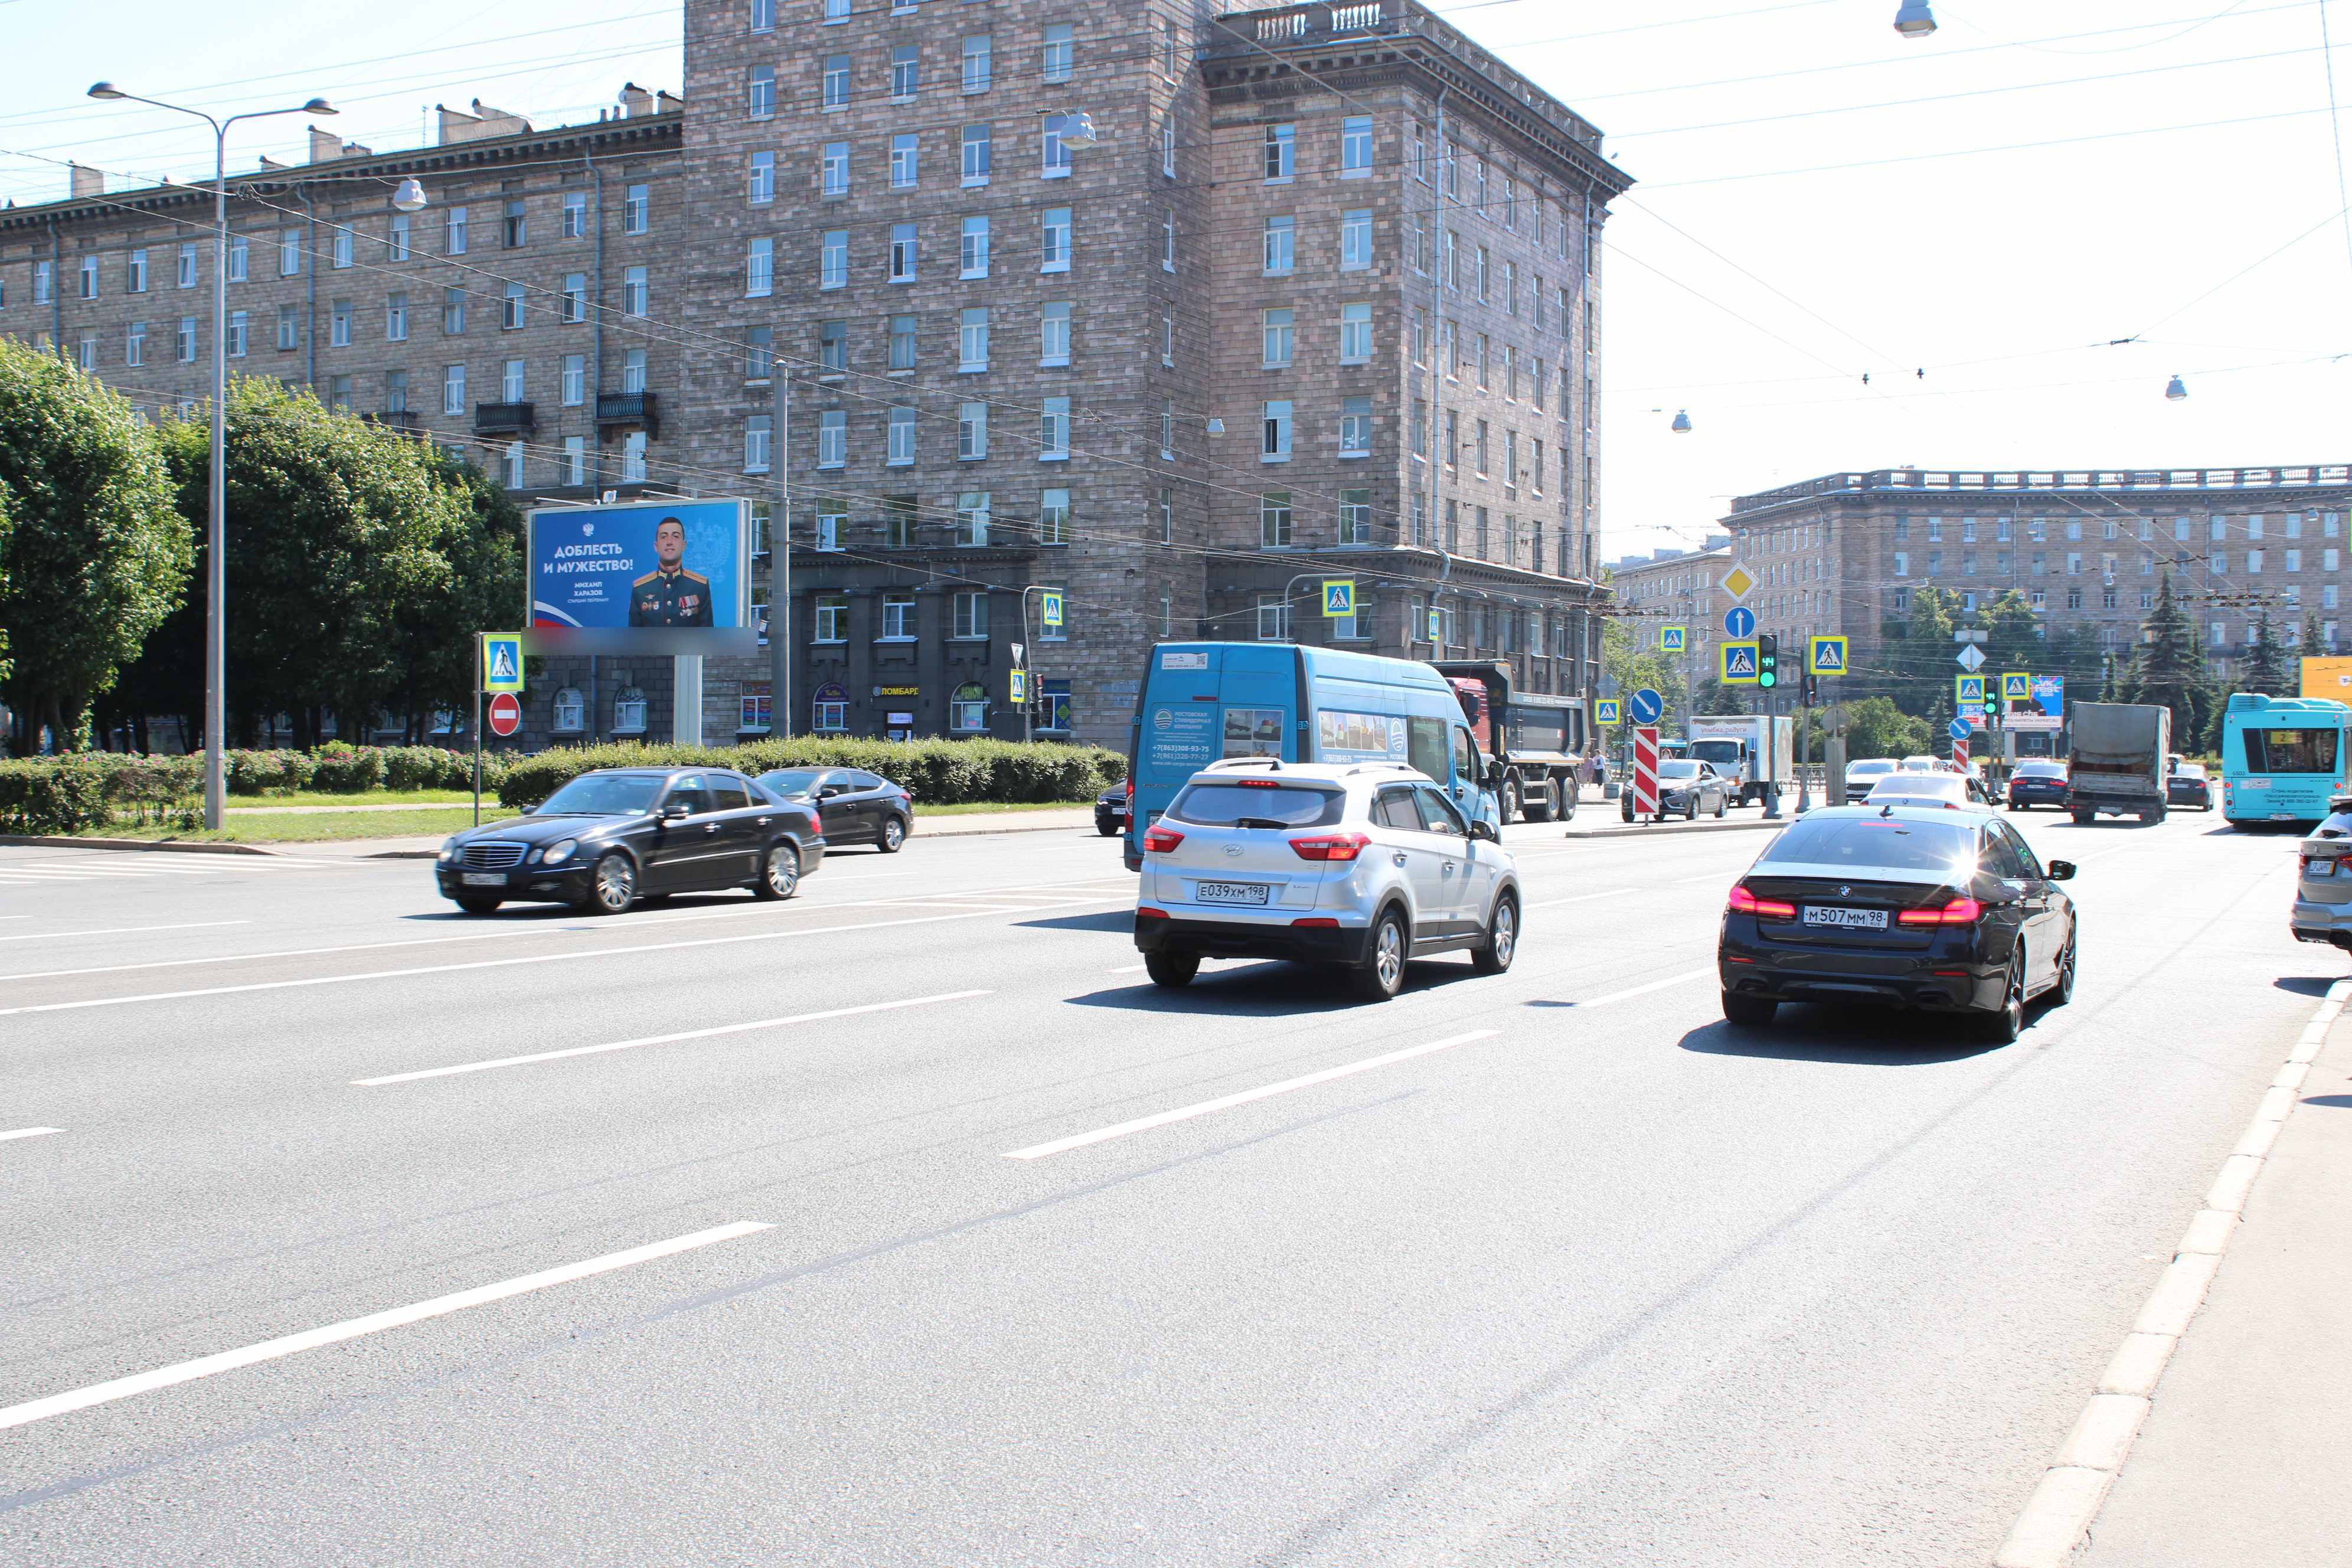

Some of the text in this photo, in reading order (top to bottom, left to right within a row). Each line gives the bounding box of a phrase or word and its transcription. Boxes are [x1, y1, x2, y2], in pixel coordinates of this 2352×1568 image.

[554, 543, 622, 558] ДОБЛЕСТЬ
[543, 558, 633, 573] И МУЖЕСТВО!
[1762, 657, 1774, 667] 44
[2281, 733, 2286, 742] 2
[1247, 886, 1264, 896] 198
[1869, 911, 1883, 922] 98
